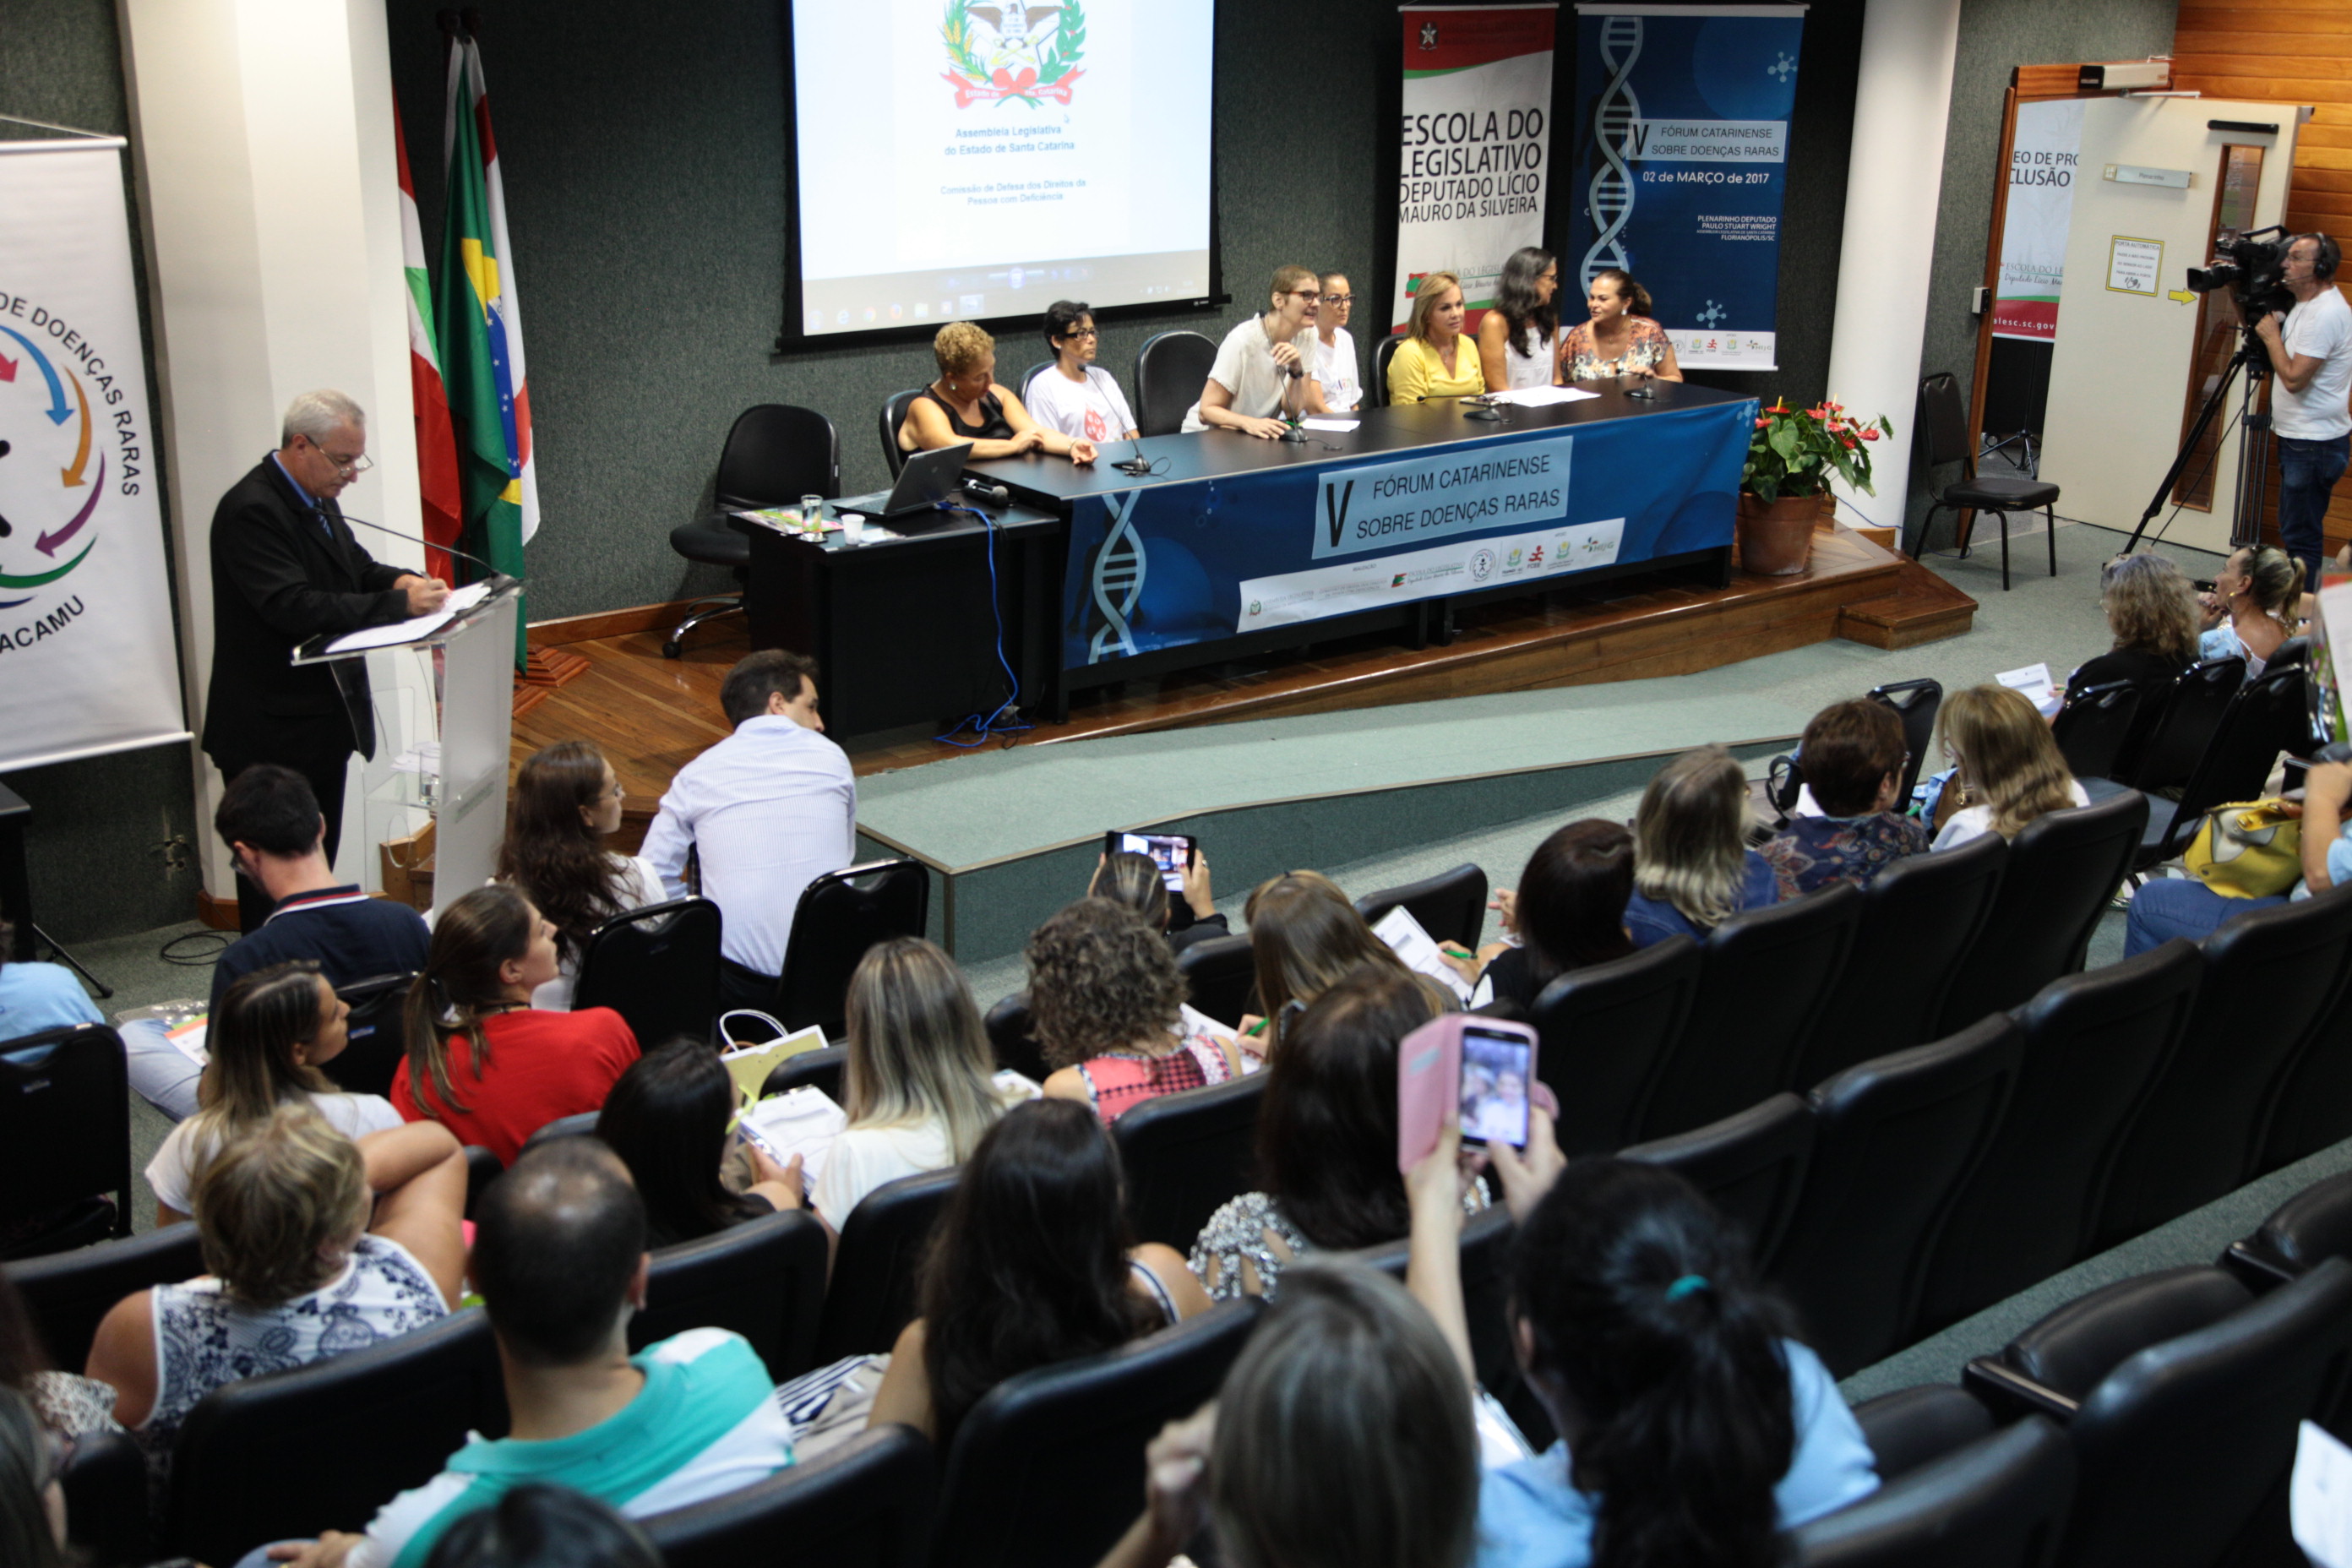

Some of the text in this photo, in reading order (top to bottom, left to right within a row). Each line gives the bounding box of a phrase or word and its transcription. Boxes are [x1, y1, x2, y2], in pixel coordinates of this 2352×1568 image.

[956, 125, 1062, 139] Assembleia Legislativa
[1402, 108, 1544, 146] ESCOLA DO
[1661, 126, 1772, 139] FÓRUM CATARINENSE
[1632, 123, 1649, 155] V
[945, 140, 1075, 155] do Estado de Santa Catarina
[1652, 144, 1779, 158] SOBRE DOENÇAS RARAS
[2034, 152, 2053, 165] DE
[940, 178, 1086, 194] Comissão de Defesa dos Direitos da
[1642, 172, 1769, 185] 02 de MARÇO de 2017
[1400, 171, 1539, 204] DEPUTADO LÍCIO
[967, 193, 1064, 205] Pessoa com Deficiência
[1399, 196, 1537, 224] MAURO DA SILVEIRA
[2006, 263, 2036, 273] ESCOLA
[2039, 265, 2052, 274] DO
[30, 308, 123, 406] DOENÇAS
[113, 411, 141, 496] RARAS
[1373, 455, 1550, 499] FÓRUM CATARINENSE
[1326, 480, 1354, 547] V
[1356, 488, 1560, 539] SOBRE DOENÇAS RARAS
